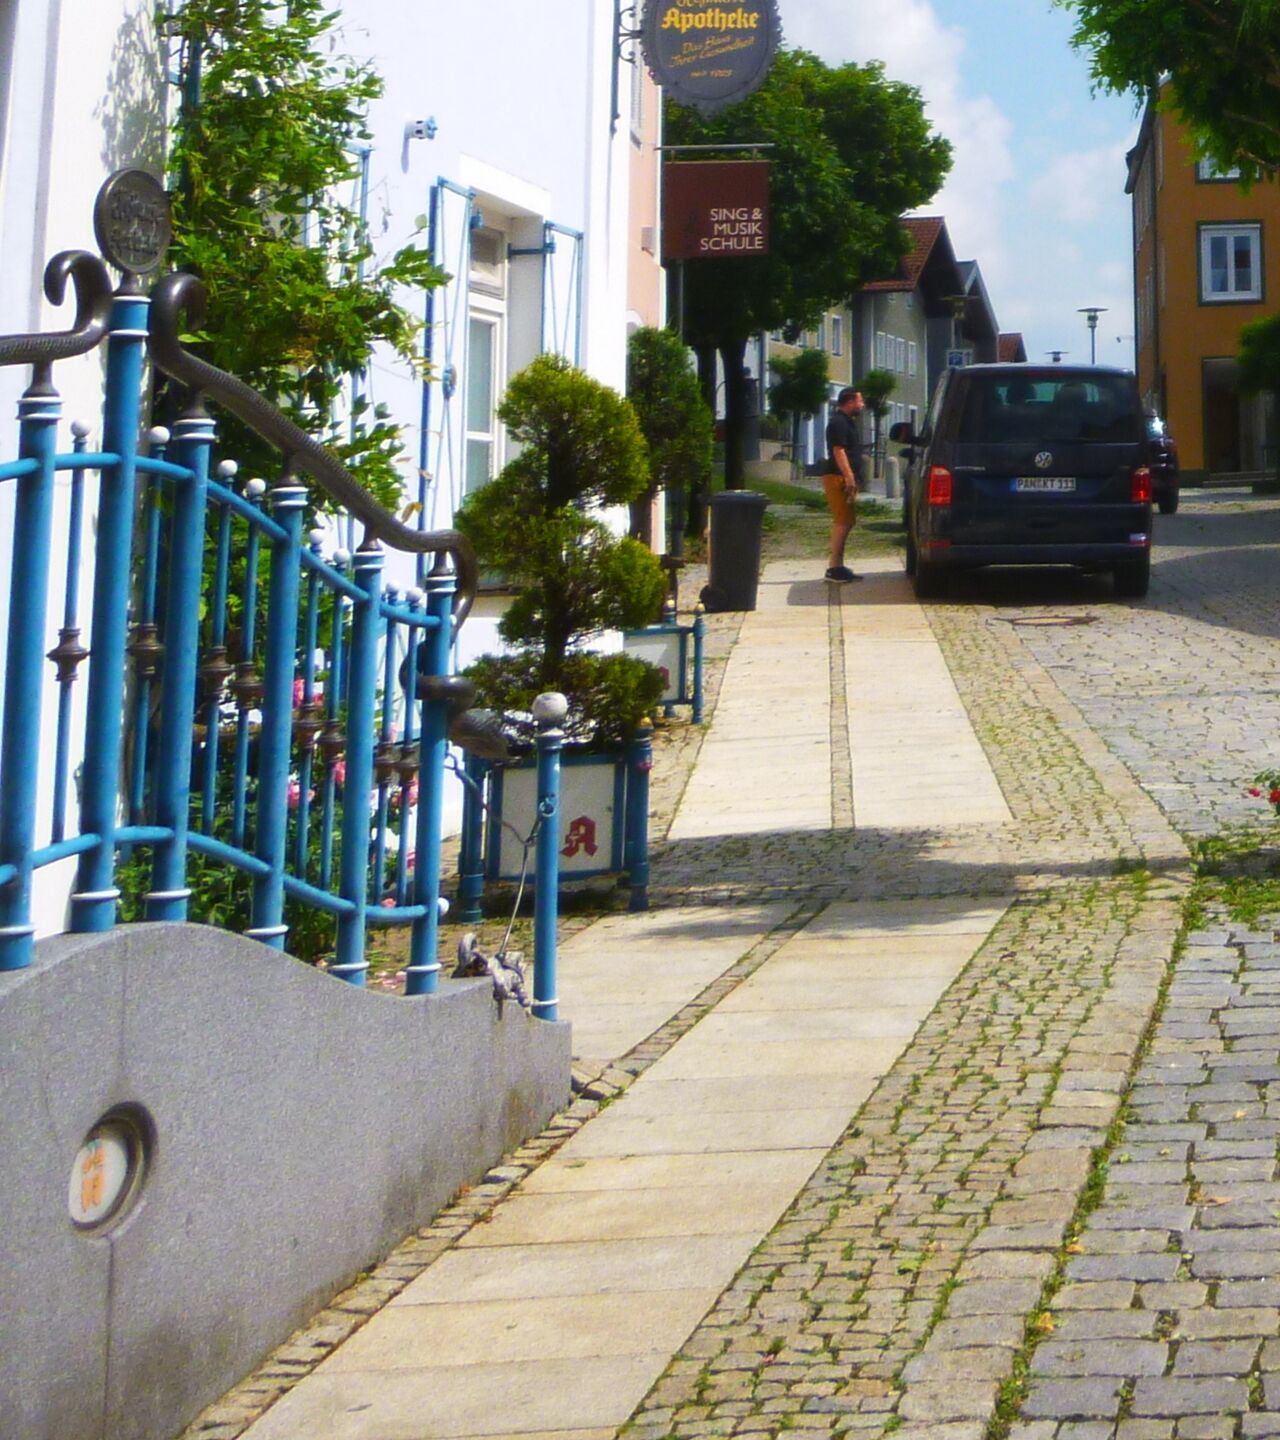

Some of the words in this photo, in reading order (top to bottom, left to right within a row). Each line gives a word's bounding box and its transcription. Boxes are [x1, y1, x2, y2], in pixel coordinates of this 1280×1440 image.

[661, 8, 759, 33] Apotheke
[710, 208, 748, 221] SING
[751, 208, 762, 220] &
[714, 222, 762, 236] MUSIK
[700, 237, 764, 251] SCHULE
